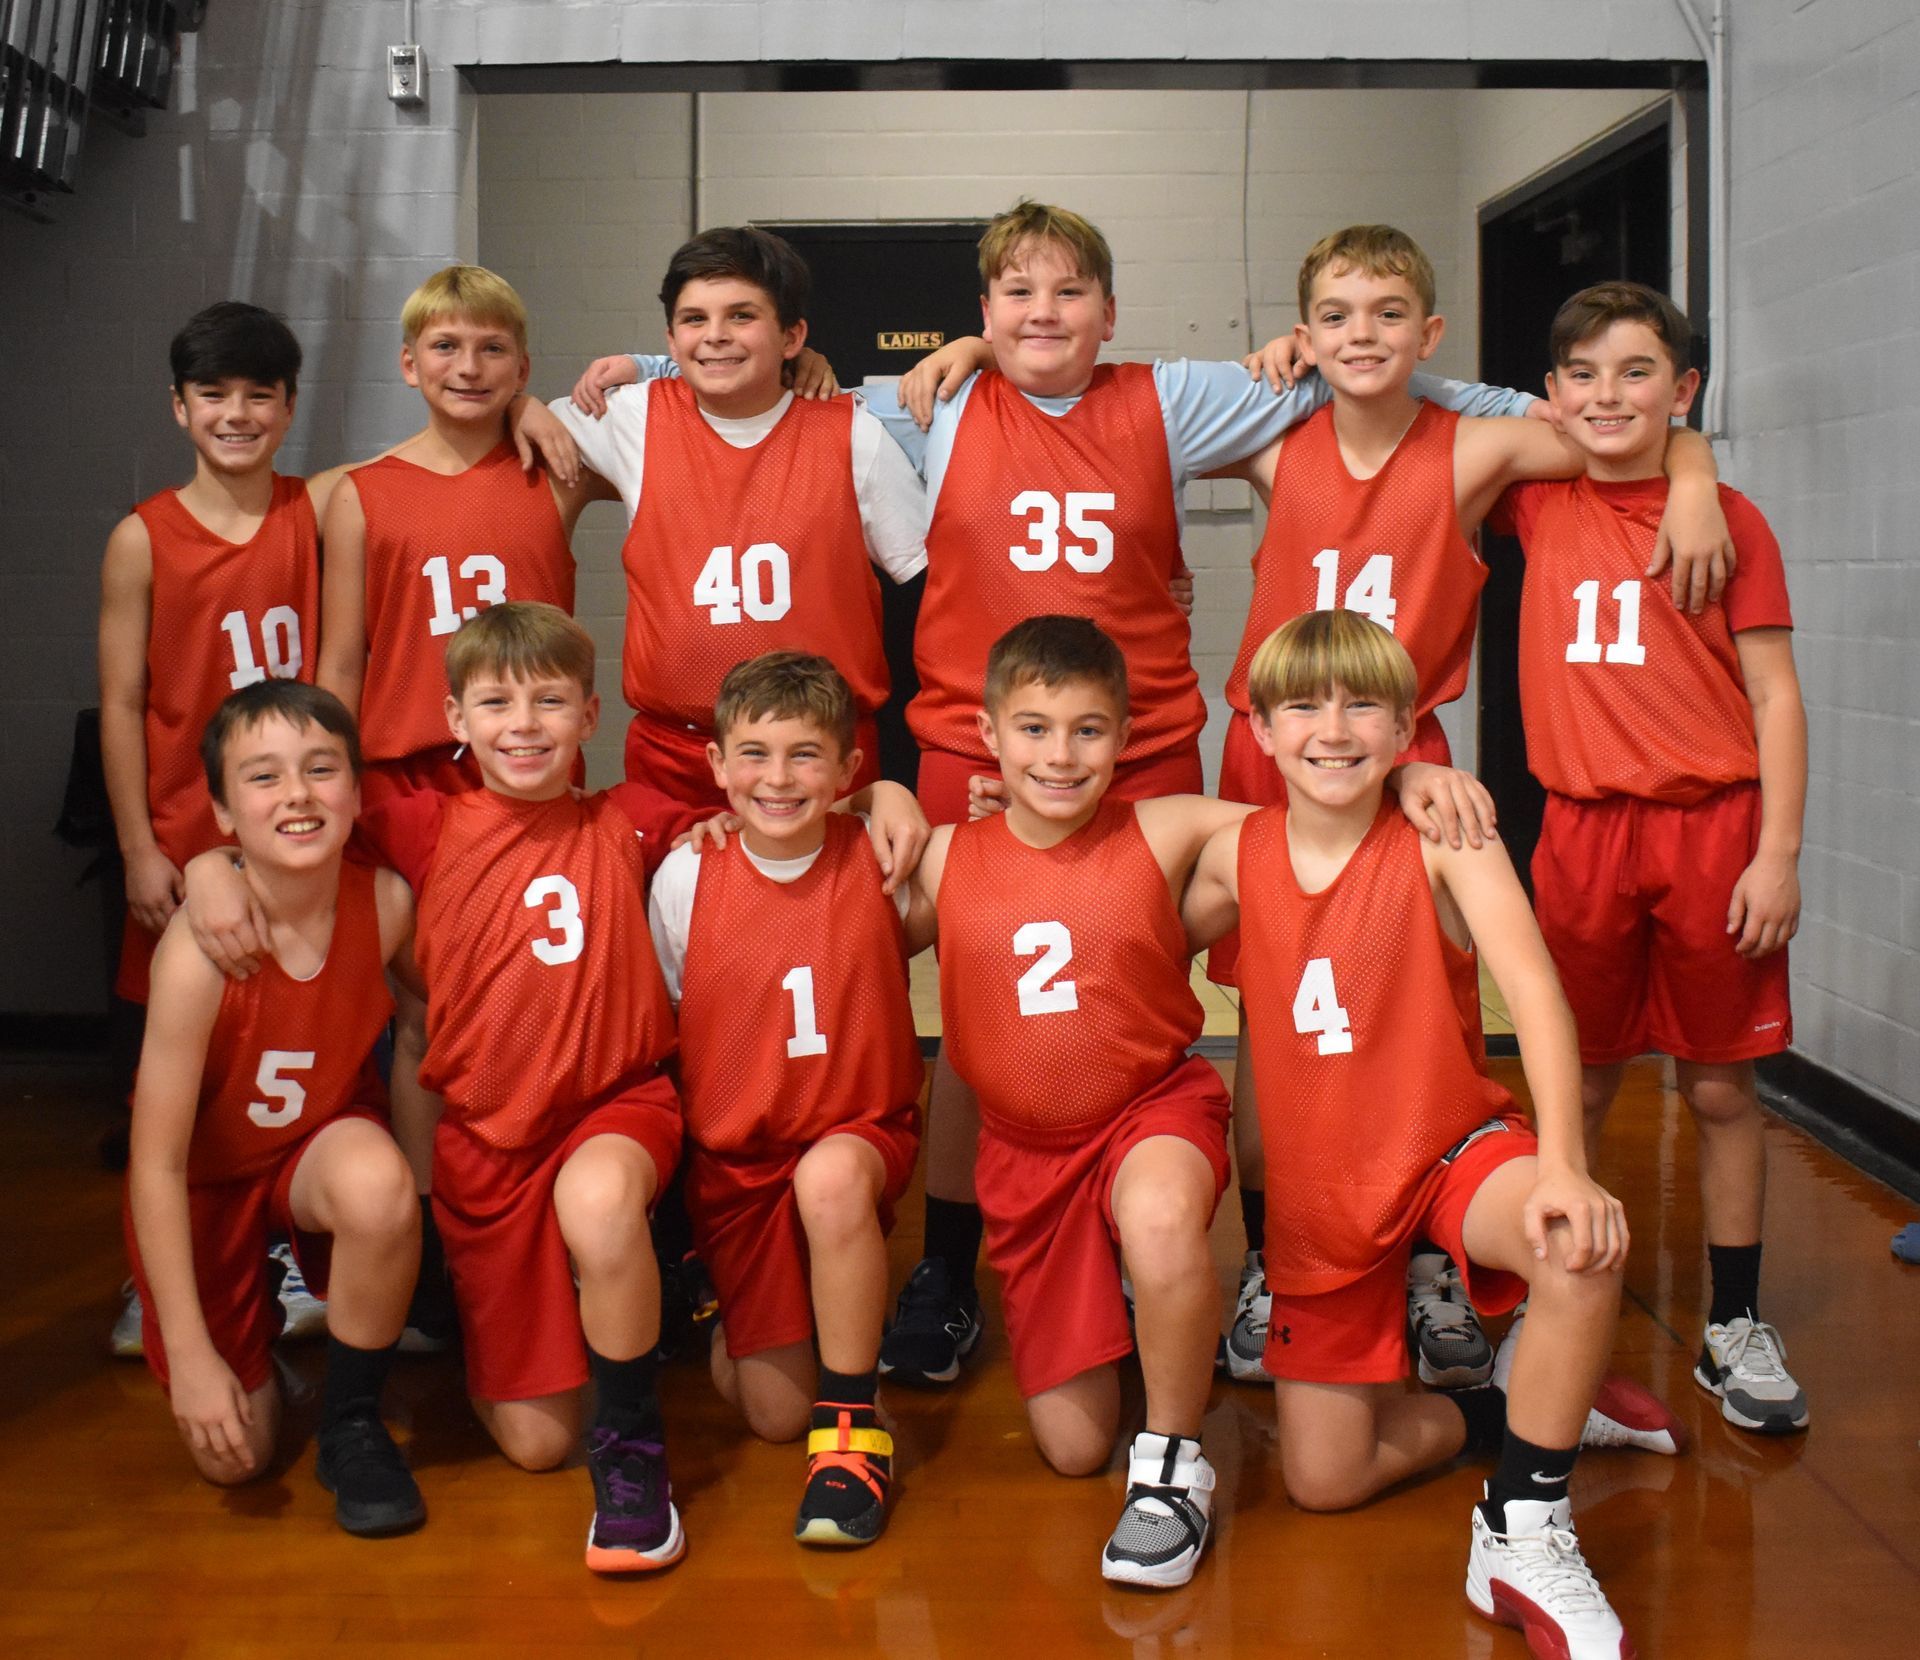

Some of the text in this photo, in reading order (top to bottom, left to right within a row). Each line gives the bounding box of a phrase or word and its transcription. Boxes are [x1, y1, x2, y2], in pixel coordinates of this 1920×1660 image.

[880, 333, 941, 347] LADIES
[1008, 490, 1116, 574] 35
[421, 554, 507, 637] 13
[692, 542, 792, 626] 40
[1311, 548, 1397, 635] 14
[1564, 579, 1646, 666] 11
[220, 605, 302, 690] 10
[523, 874, 585, 966] 3
[1011, 919, 1079, 1017] 2
[1292, 957, 1354, 1056] 4
[781, 965, 828, 1059] 1
[248, 1050, 315, 1127] 5
